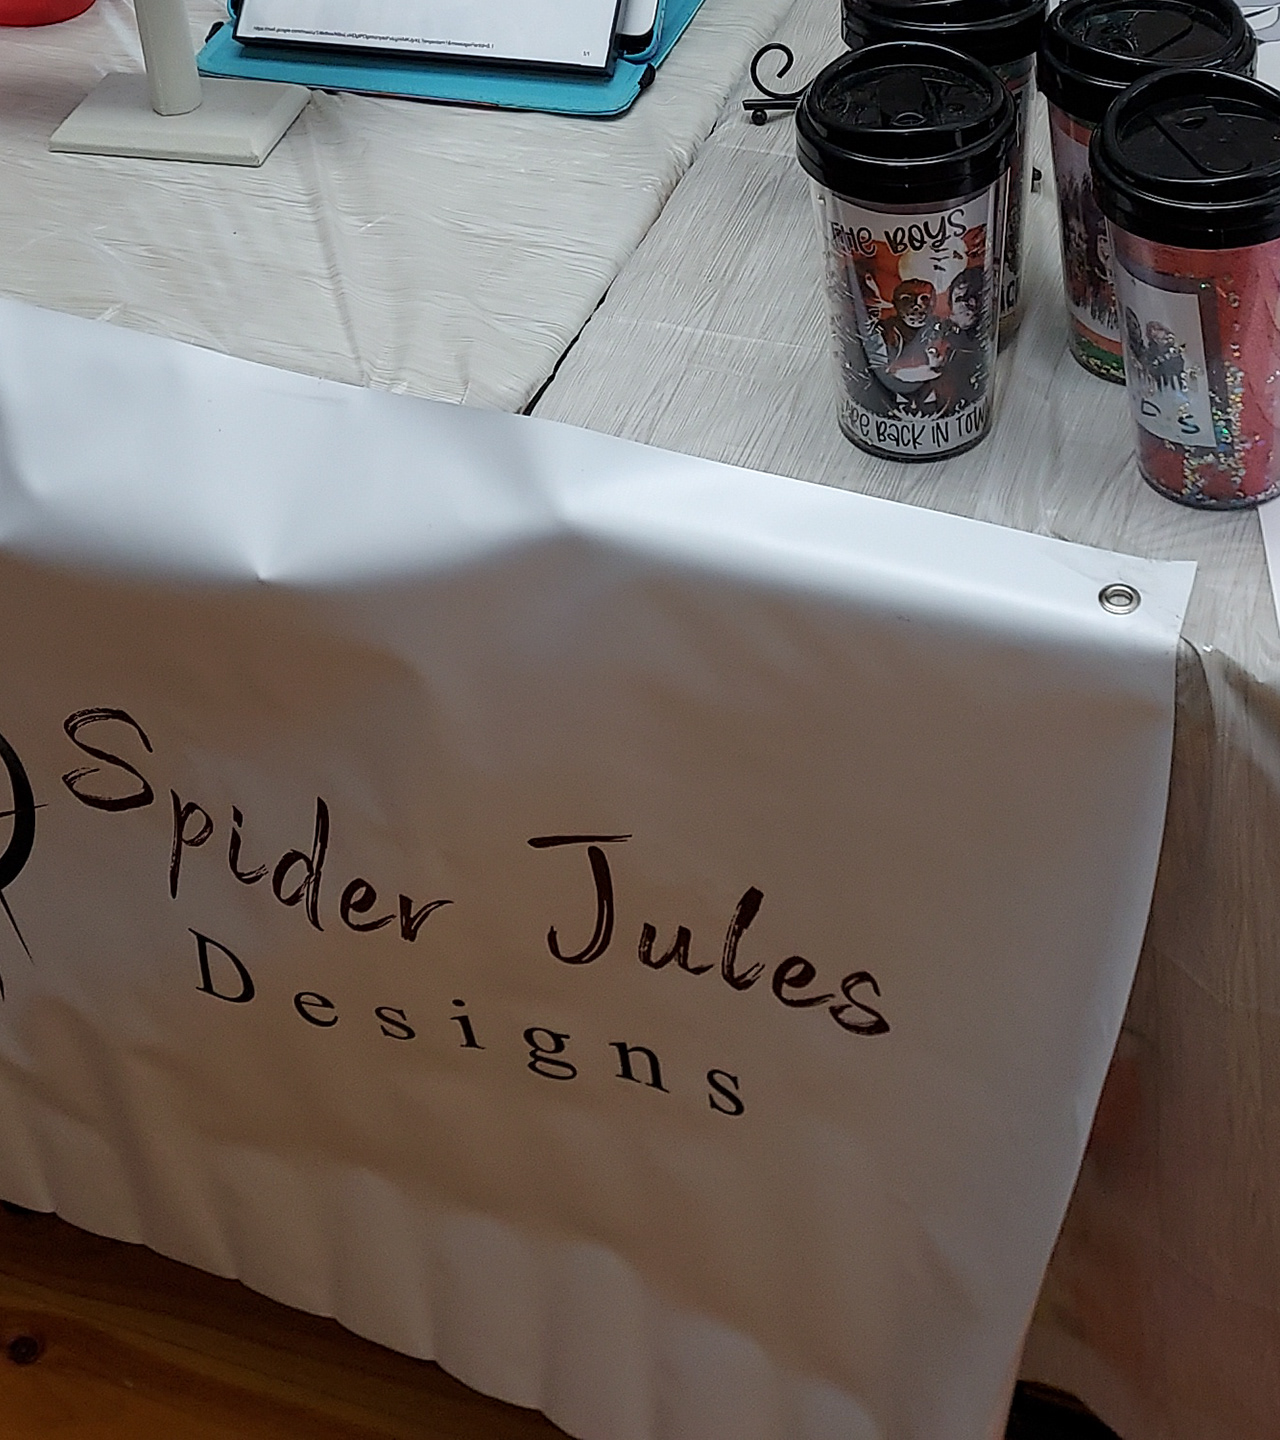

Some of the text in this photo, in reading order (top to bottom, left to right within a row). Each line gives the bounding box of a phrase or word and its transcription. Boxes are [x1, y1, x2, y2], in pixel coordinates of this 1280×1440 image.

[931, 421, 949, 448] IN
[62, 707, 890, 1036] Spider Jules
[189, 928, 746, 1116] Designs
